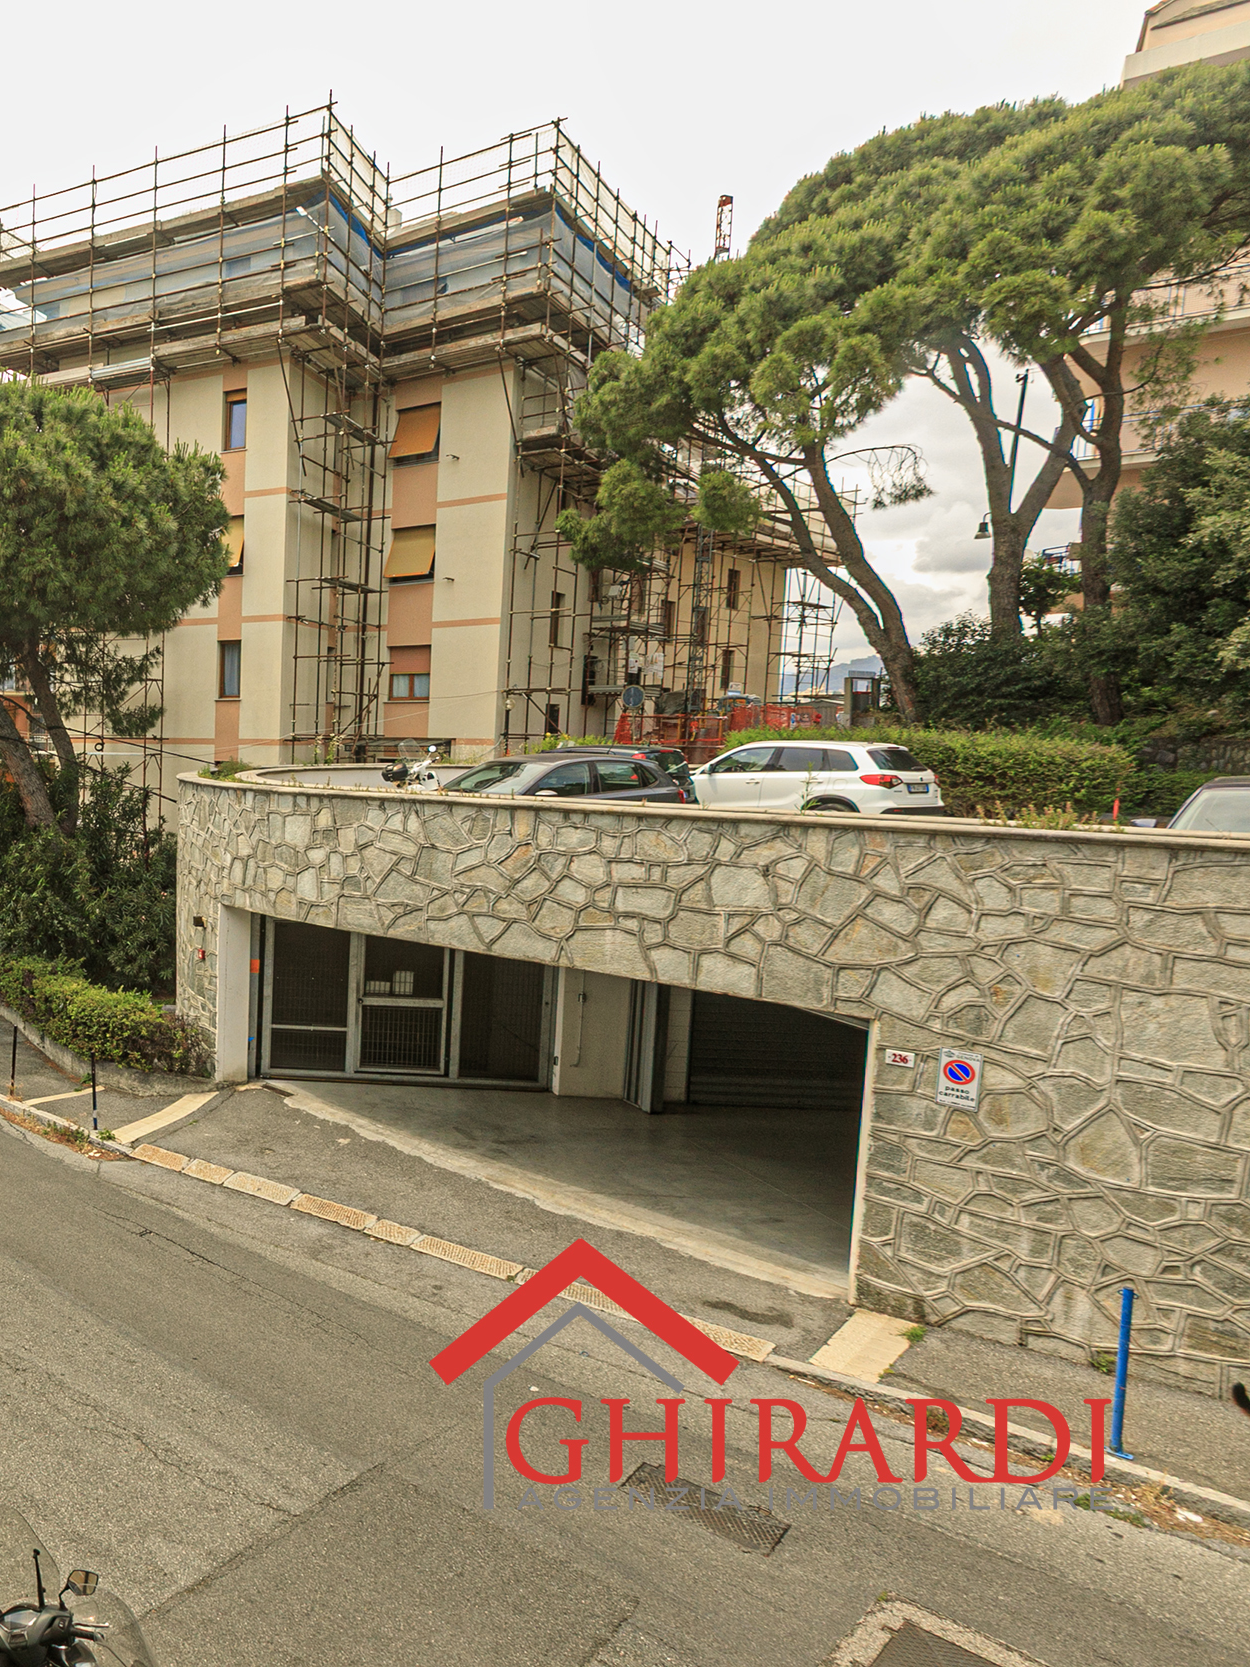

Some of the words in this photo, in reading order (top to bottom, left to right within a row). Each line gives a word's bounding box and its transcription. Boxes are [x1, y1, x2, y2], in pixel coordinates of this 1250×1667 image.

[891, 1053, 909, 1064] 236
[944, 1086, 970, 1094] passo
[938, 1091, 975, 1102] carrabile
